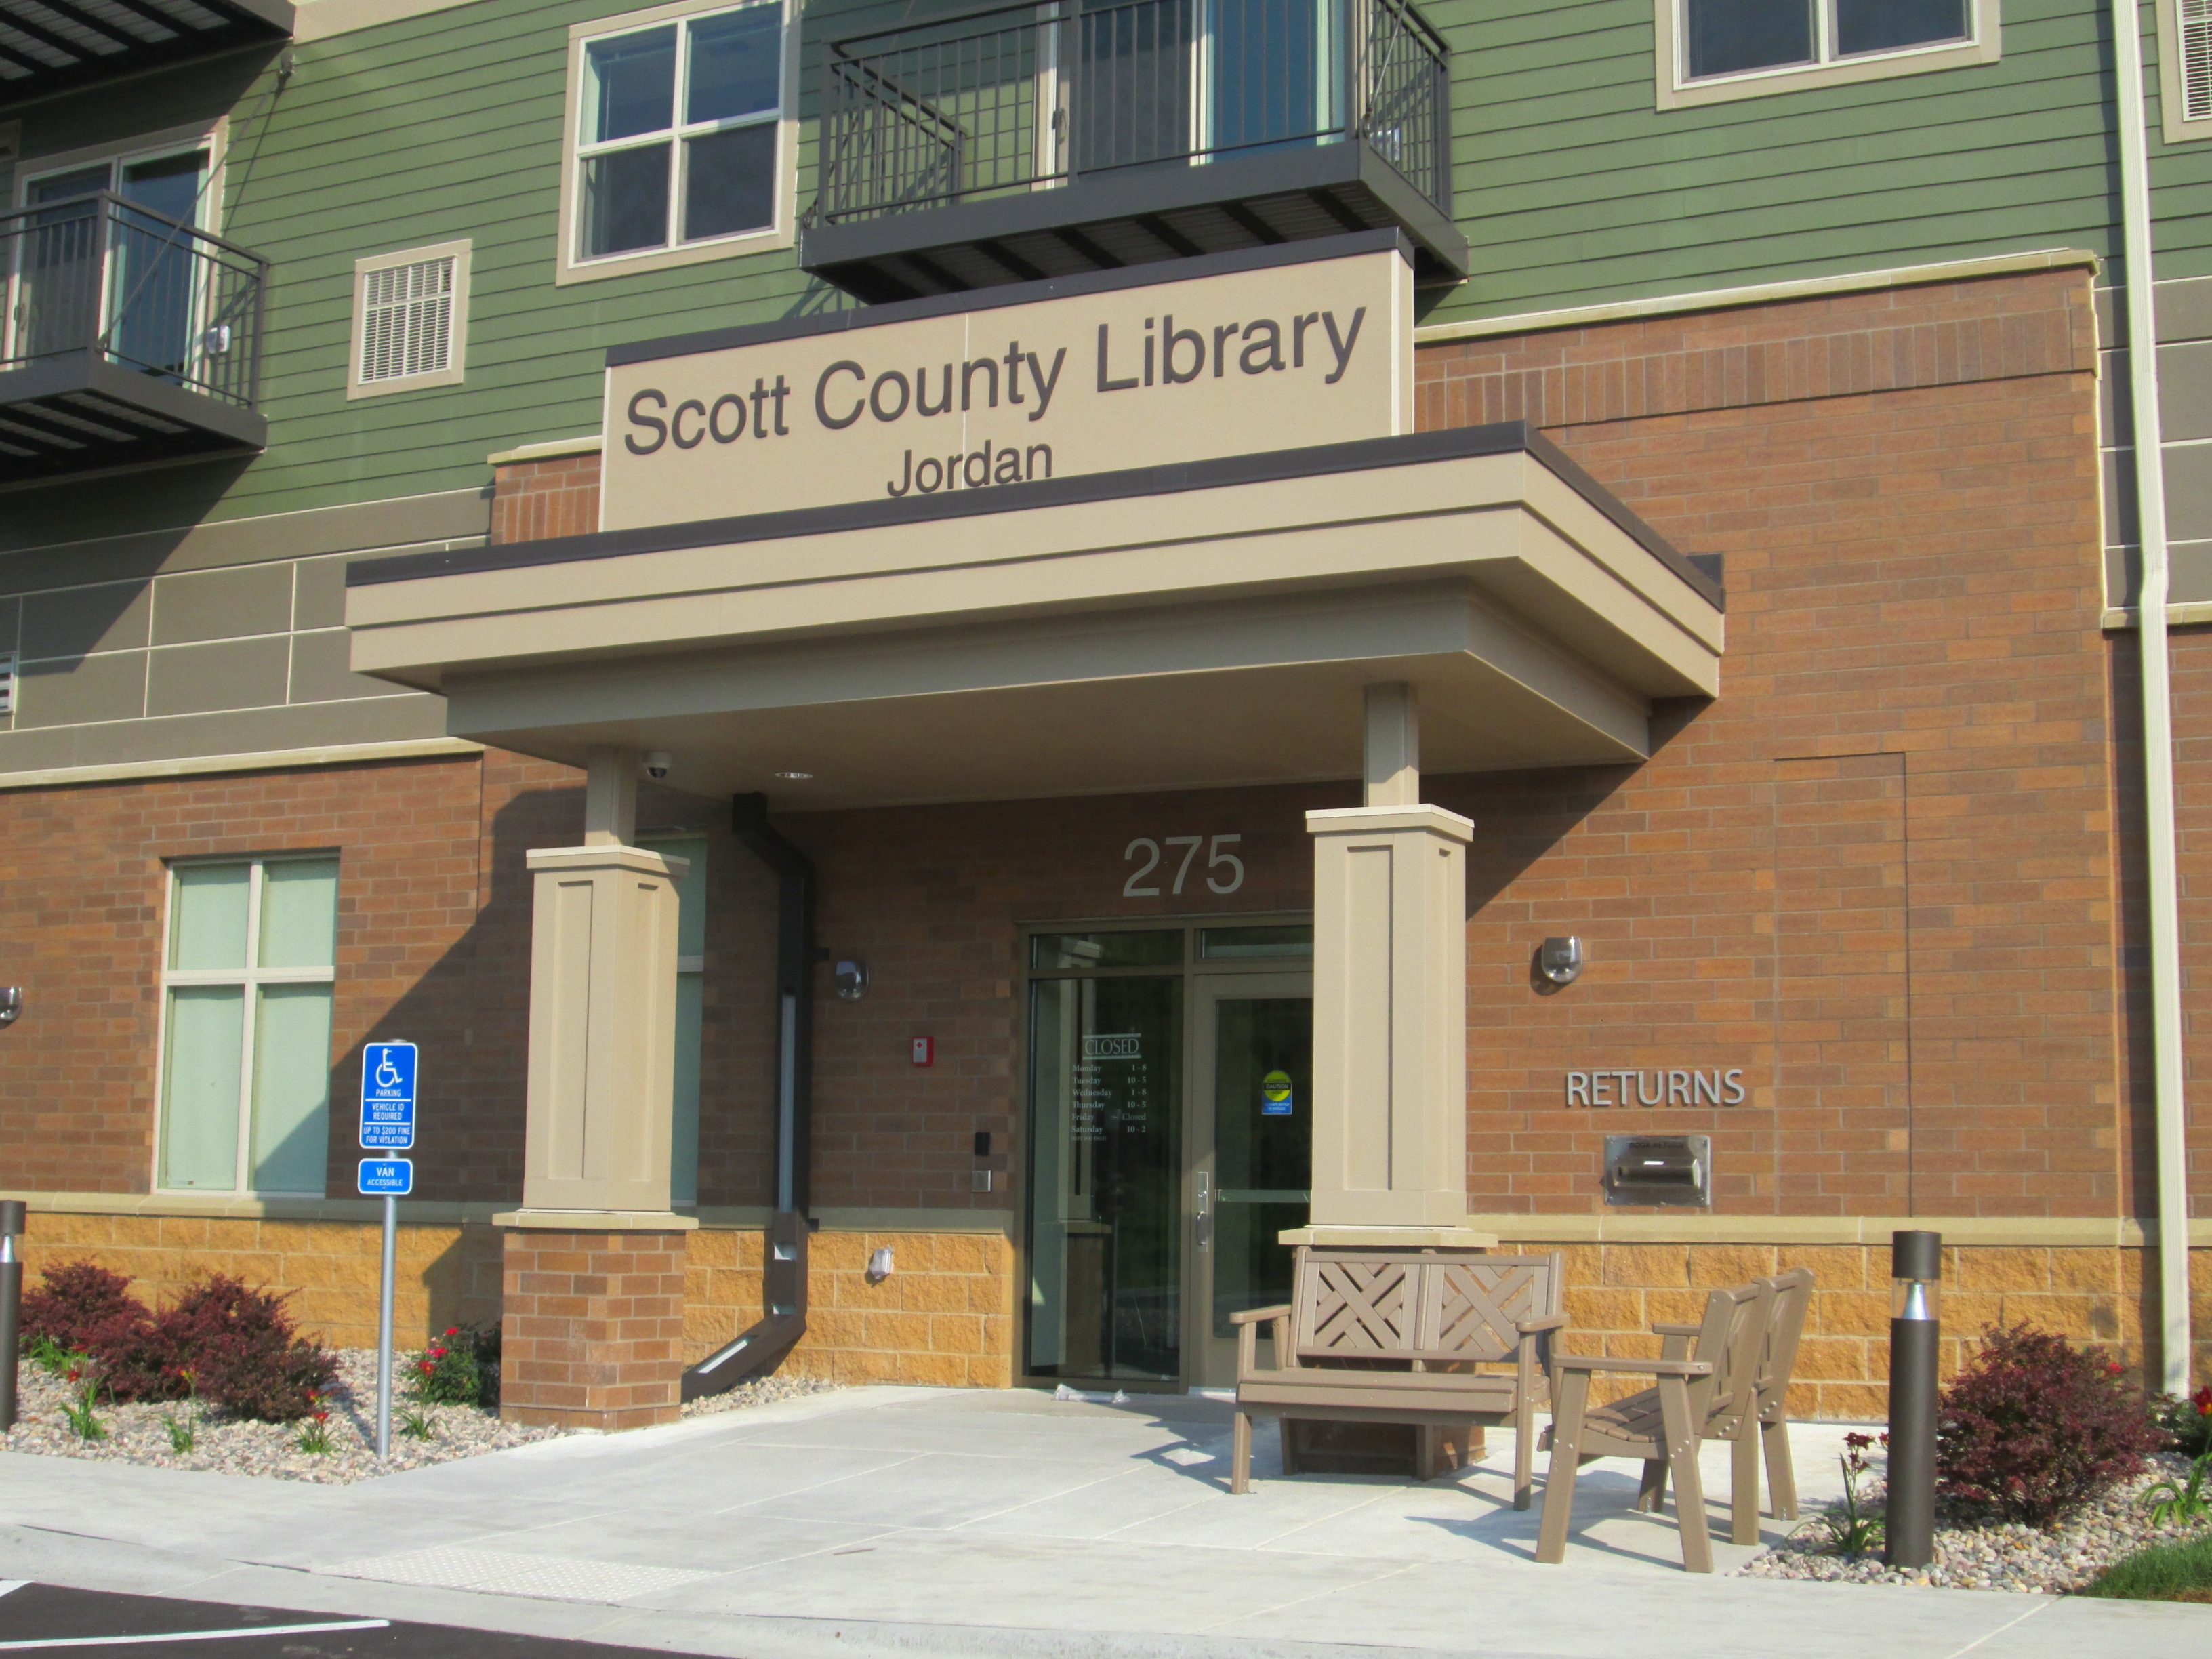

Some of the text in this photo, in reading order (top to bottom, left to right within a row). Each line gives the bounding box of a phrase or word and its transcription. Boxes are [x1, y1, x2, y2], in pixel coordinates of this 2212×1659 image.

[623, 306, 1368, 457] Scott County Library
[886, 438, 1053, 497] Jordan
[1122, 833, 1245, 897] 275
[1085, 1038, 1139, 1055] CLOSED
[1072, 1064, 1102, 1073] Monday
[1073, 1076, 1101, 1086] Tuesday
[375, 1088, 401, 1097] PARKING
[1566, 1069, 1745, 1107] RETURNS
[1073, 1088, 1113, 1099] Wednesday
[372, 1103, 405, 1111] VEHICLE ID
[1072, 1101, 1105, 1111] Thursday
[373, 1111, 403, 1120] REQUIRED
[1072, 1113, 1147, 1122] Friday Closed
[363, 1126, 411, 1136] UP TO $200 FINE
[1071, 1125, 1104, 1135] Saturday
[365, 1136, 408, 1145] FOR VIOLATION
[376, 1167, 394, 1177] VAN
